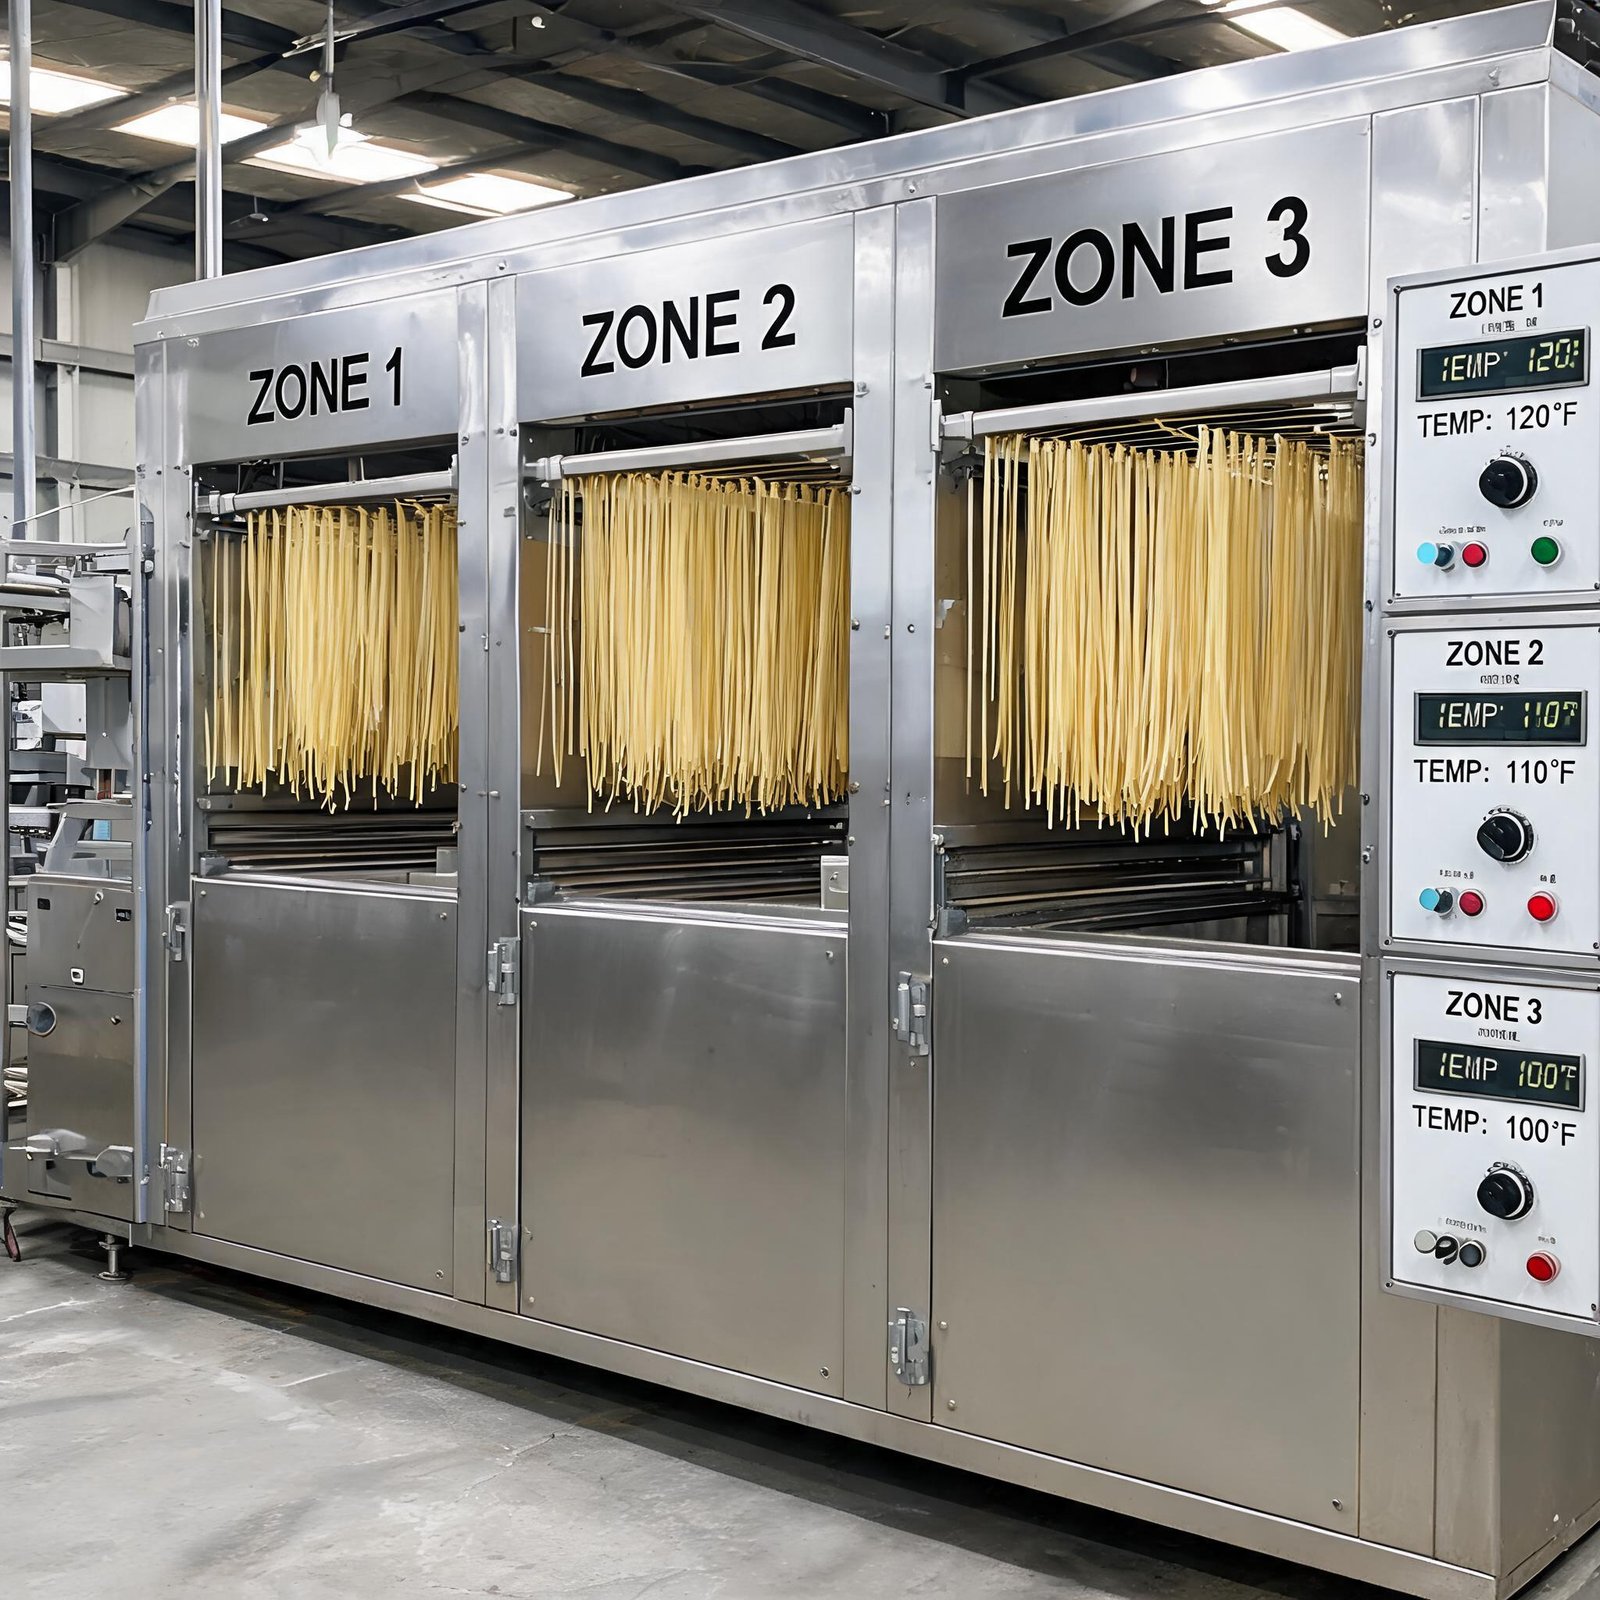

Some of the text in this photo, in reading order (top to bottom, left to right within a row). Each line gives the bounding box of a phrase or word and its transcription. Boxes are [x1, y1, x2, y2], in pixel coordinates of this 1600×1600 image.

[1002, 196, 1311, 318] ZONE 3
[1449, 282, 1543, 320] ZONE 1
[580, 283, 796, 378] ZONE 2
[247, 346, 402, 426] ZONE 1
[1417, 402, 1578, 438] TEMP: 120°F
[1445, 639, 1544, 667] ZONE 2
[1413, 759, 1576, 785] TEMP: 110°F
[1445, 990, 1542, 1025] ZONE 3
[1412, 1104, 1487, 1135] TEMP:
